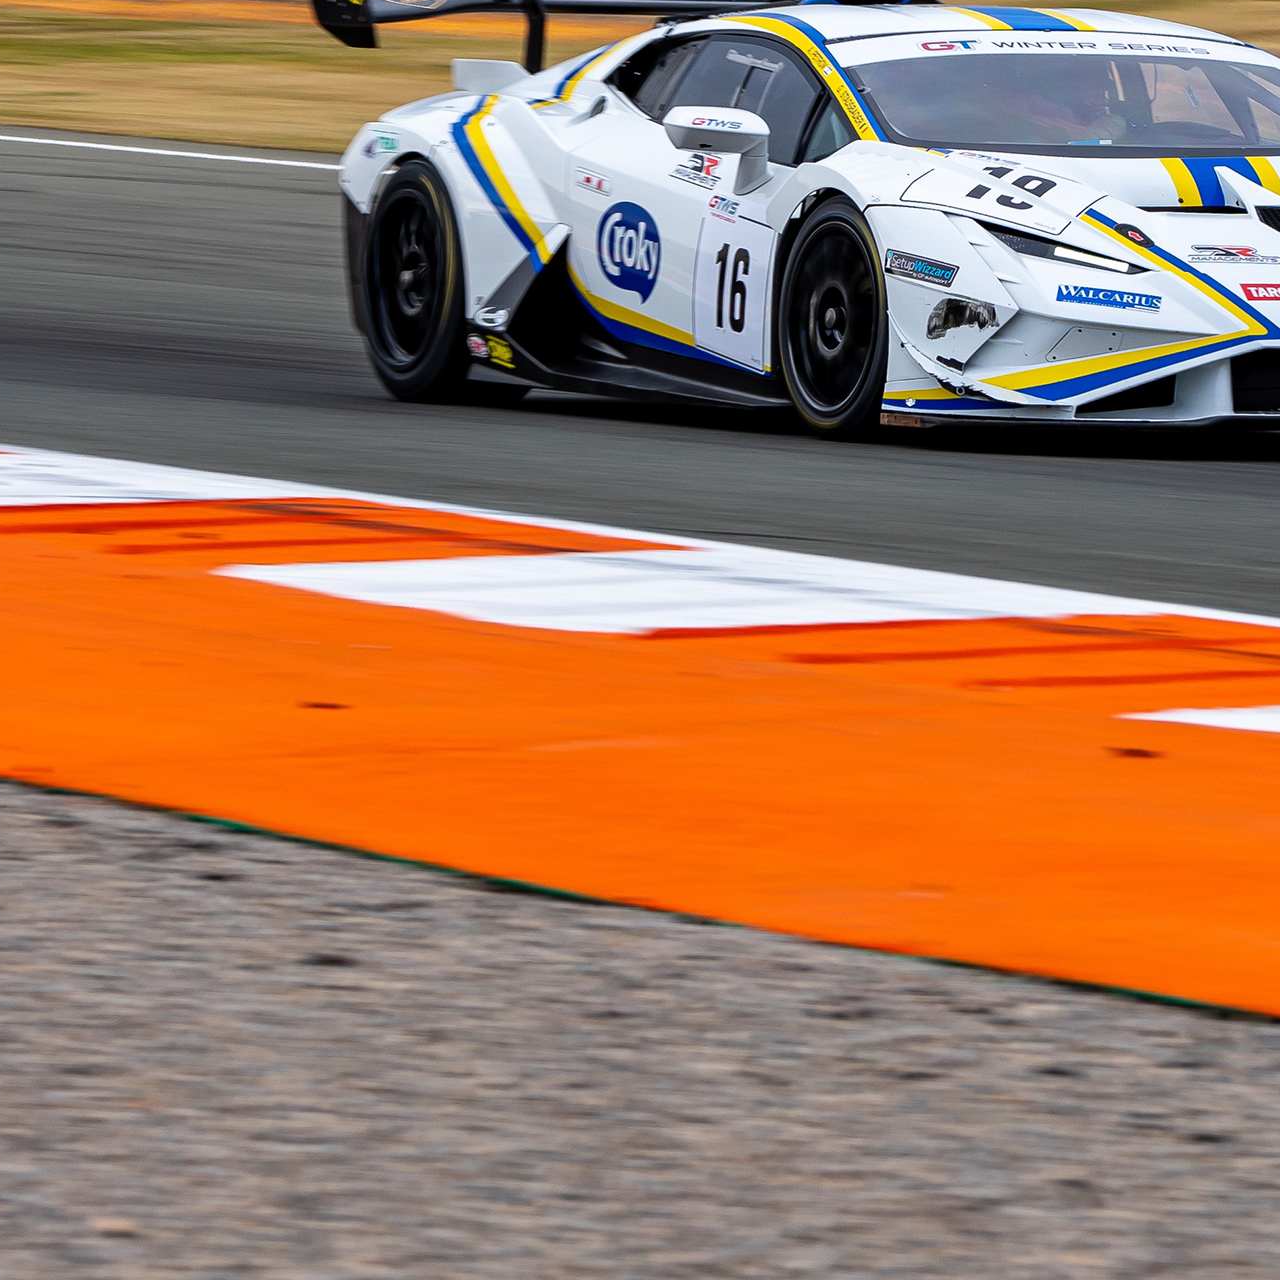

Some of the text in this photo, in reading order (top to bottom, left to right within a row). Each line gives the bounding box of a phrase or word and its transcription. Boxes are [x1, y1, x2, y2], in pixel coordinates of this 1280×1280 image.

[921, 40, 1210, 55] GT WINTER SERIES
[691, 117, 743, 130] GTWS
[708, 194, 740, 215] GTWS
[600, 212, 658, 280] Croky
[891, 254, 953, 280] SetupWizzard
[715, 242, 750, 333] 16
[1059, 284, 1161, 308] WALCARIUS
